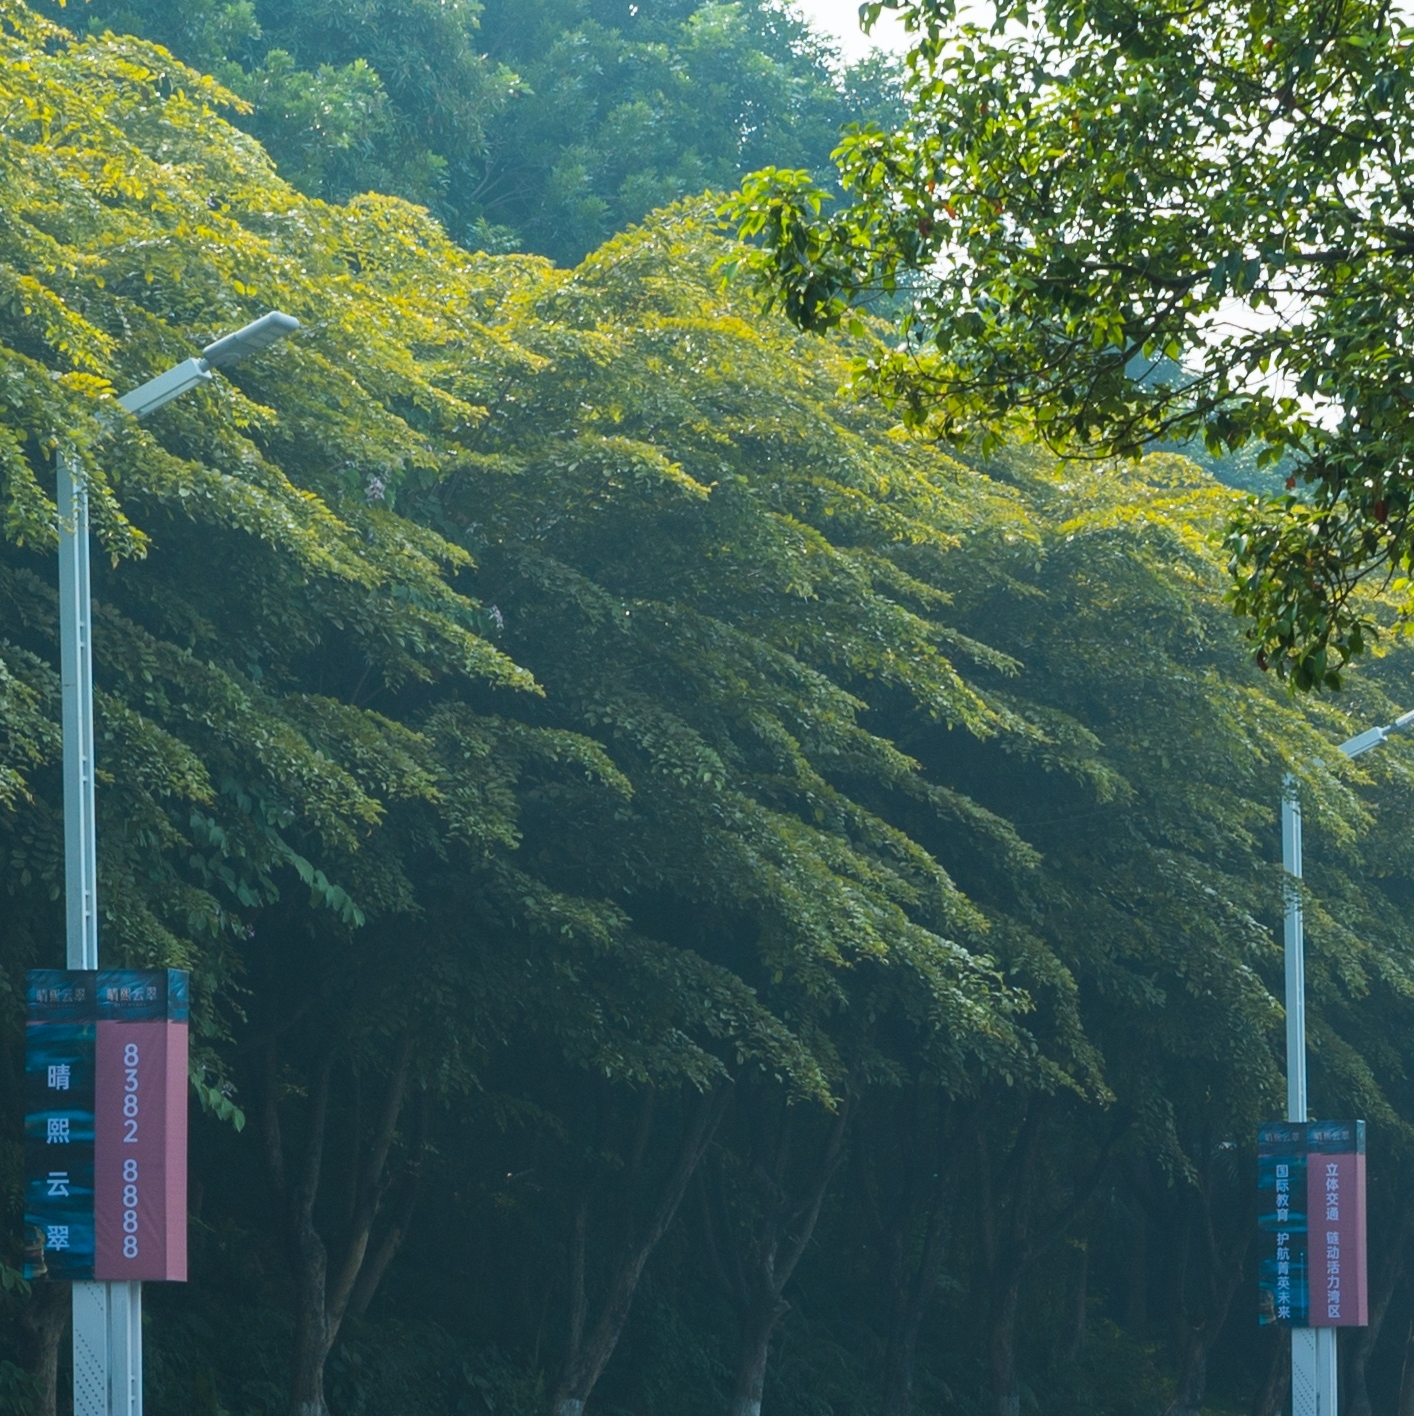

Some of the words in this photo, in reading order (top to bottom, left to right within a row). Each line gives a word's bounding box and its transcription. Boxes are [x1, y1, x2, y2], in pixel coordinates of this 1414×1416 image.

[123, 1043, 139, 1143] 8382
[46, 1064, 71, 1252] 晴熙云翠
[1275, 1164, 1290, 1222] 国际教育
[1325, 1163, 1339, 1221] 立体交通
[122, 1159, 138, 1259] 8888
[1326, 1231, 1341, 1318] 链动活力湾区
